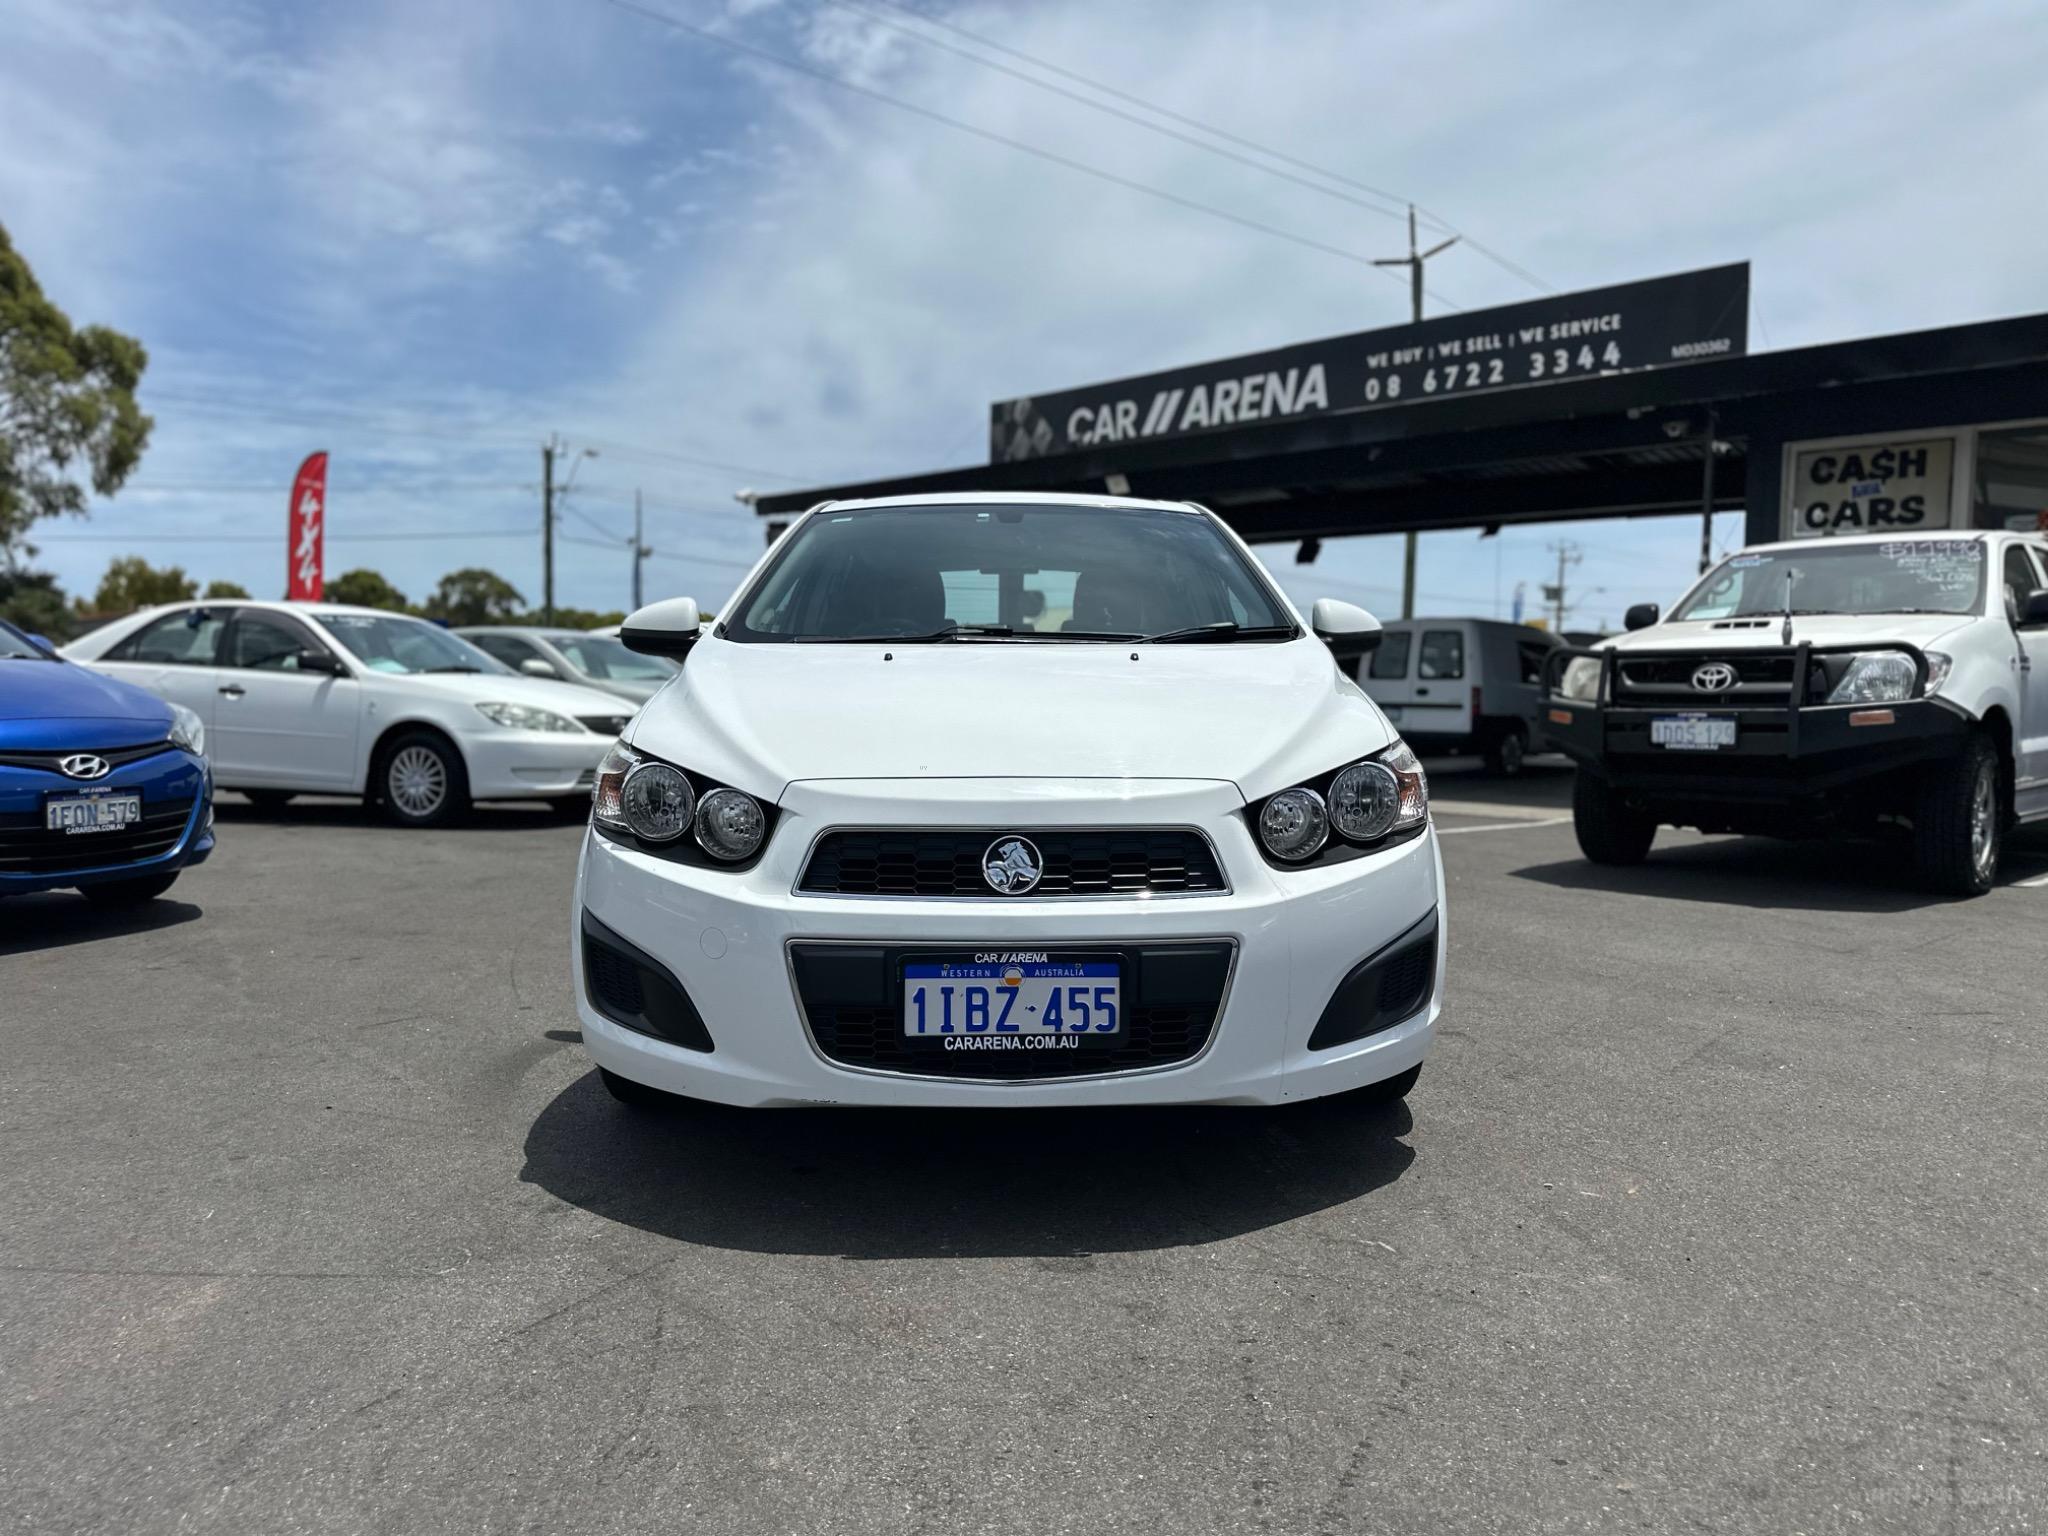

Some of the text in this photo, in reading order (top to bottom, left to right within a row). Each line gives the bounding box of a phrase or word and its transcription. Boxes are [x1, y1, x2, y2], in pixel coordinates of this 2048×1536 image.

[1366, 355, 1389, 369] WE
[1392, 347, 1423, 365] BUY
[1438, 341, 1462, 357] WE
[1466, 334, 1502, 354] SELL
[1519, 327, 1545, 345] WE
[1549, 314, 1622, 341] SERVICE
[1365, 340, 1622, 402] 08 6722 3344
[1067, 398, 1138, 446] CAR
[1179, 362, 1329, 432] ARENA
[1805, 495, 1926, 529] CARS
[974, 953, 998, 963] CAR
[1009, 953, 1048, 963] ARENA
[941, 969, 991, 978] WESTERN
[1034, 968, 1085, 977] AUSTRALIA
[944, 1035, 1079, 1051] CARARENA.COM.AU
